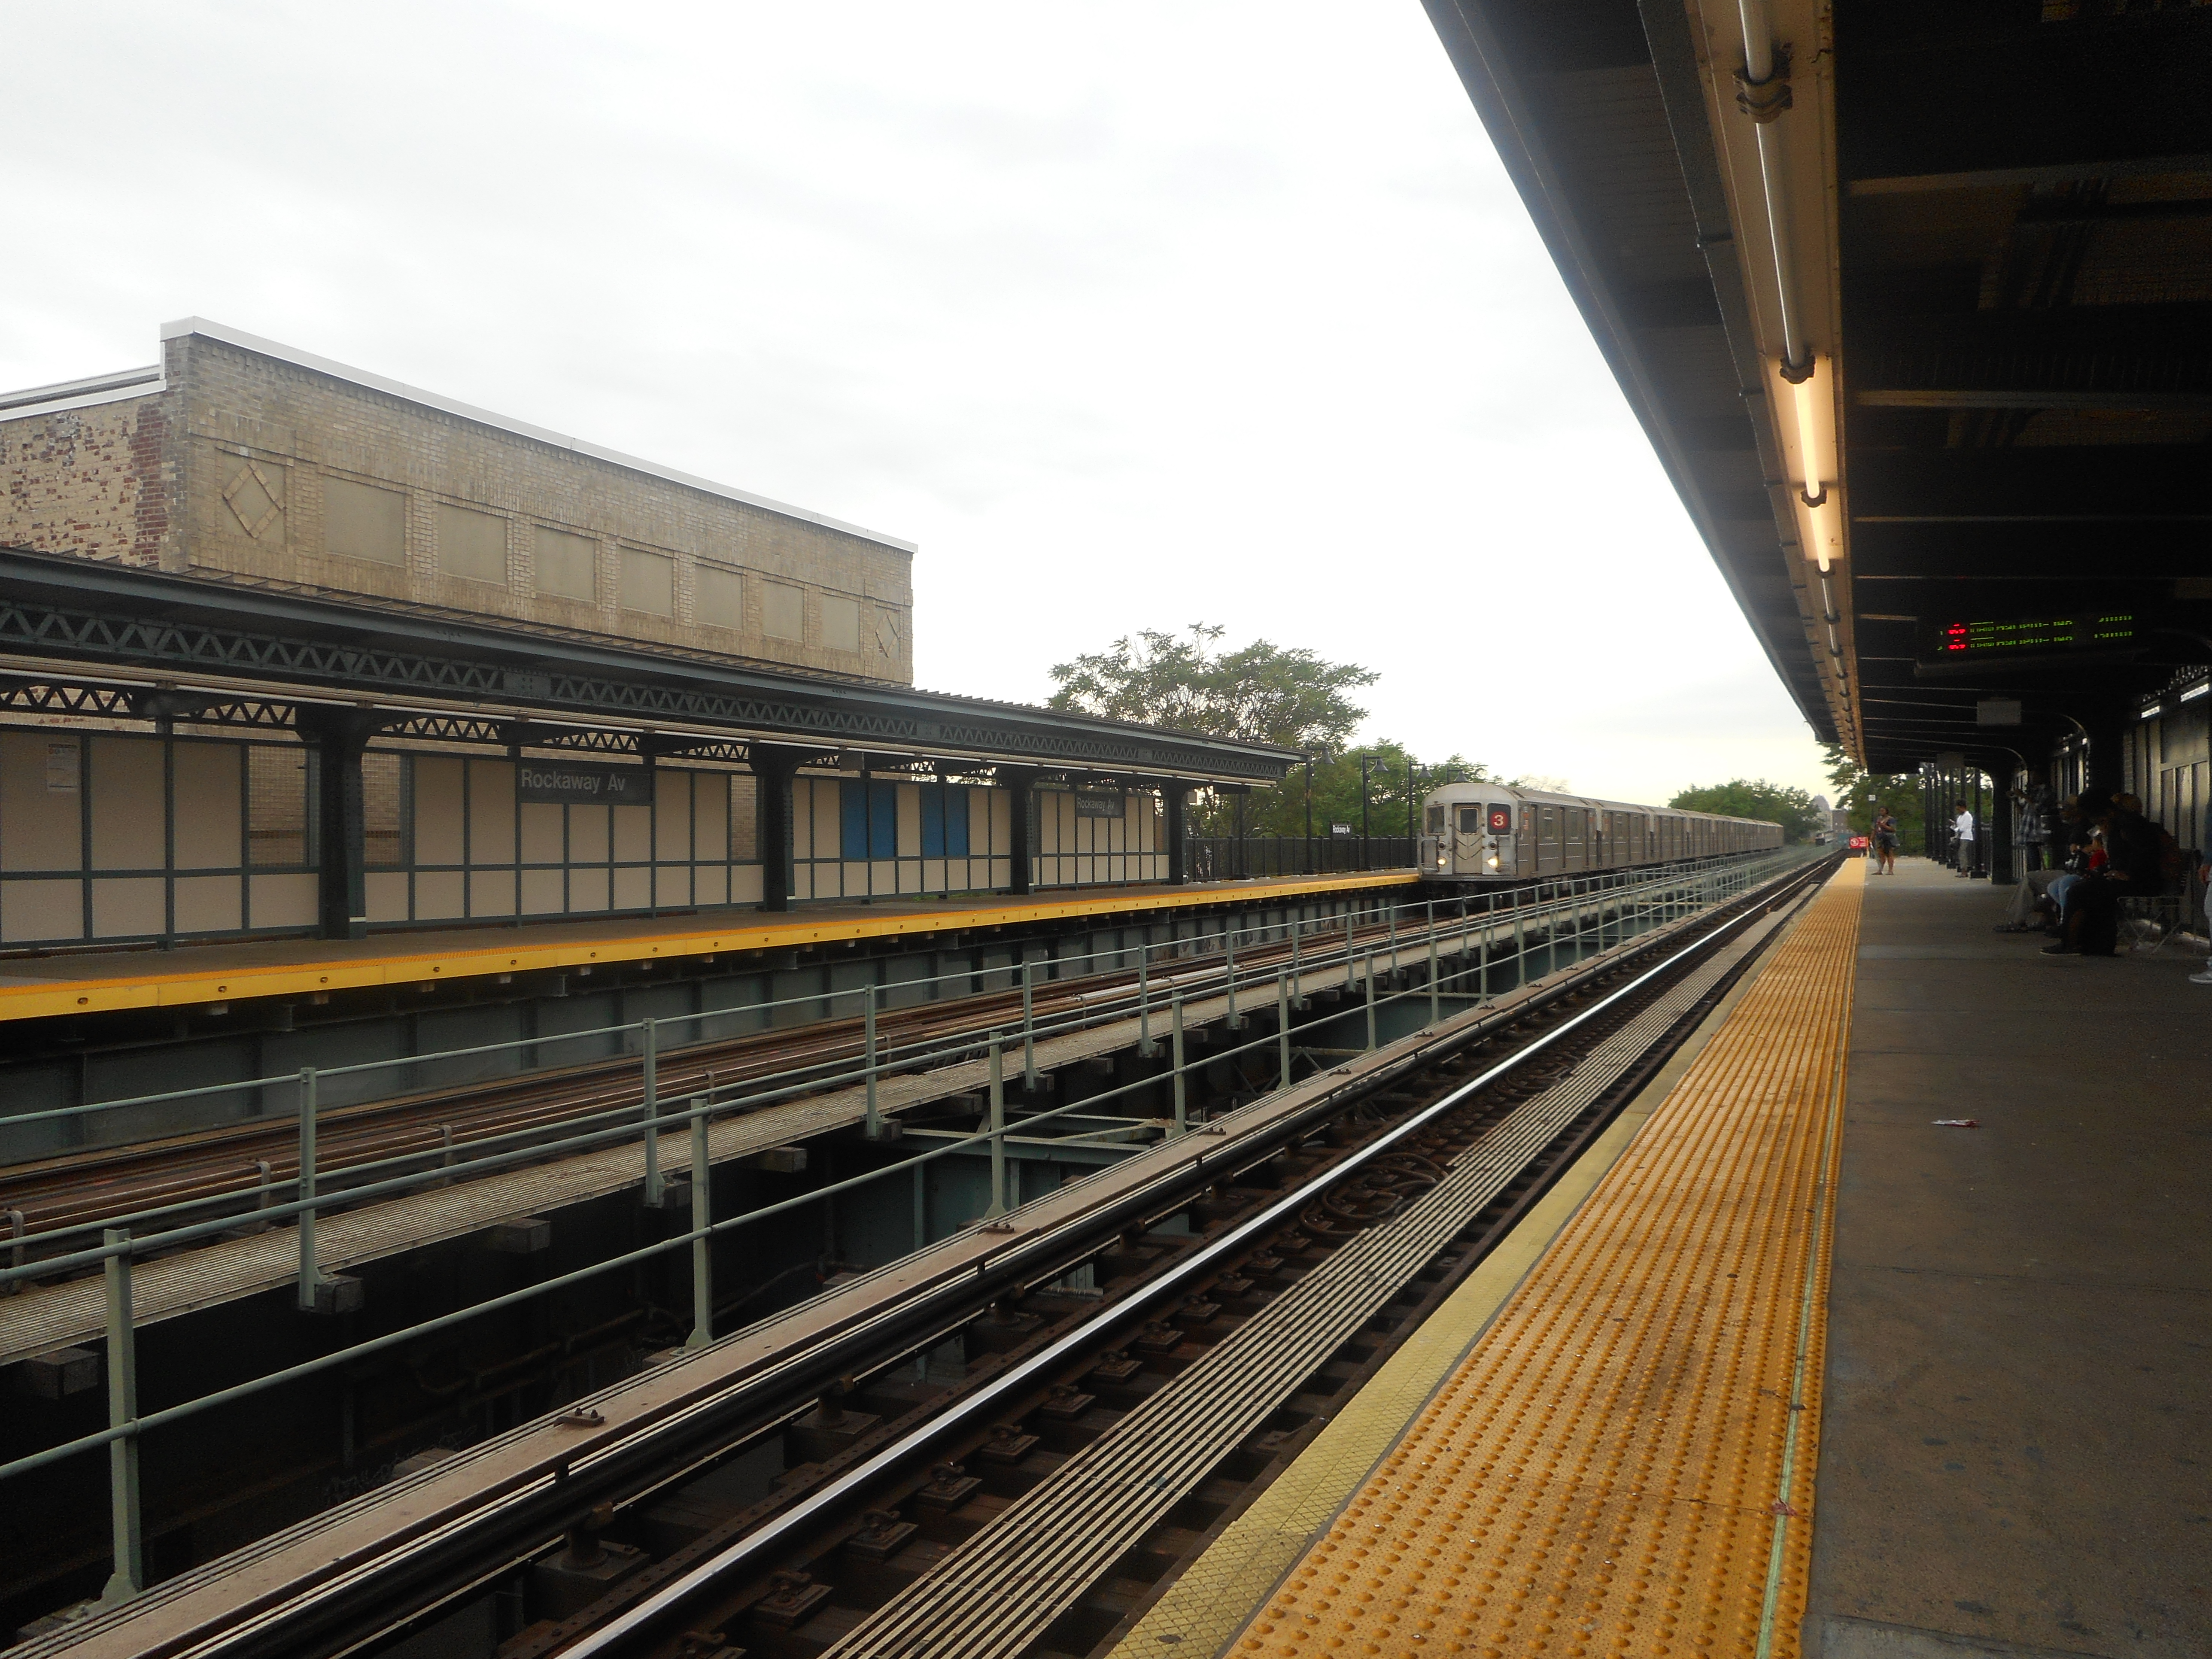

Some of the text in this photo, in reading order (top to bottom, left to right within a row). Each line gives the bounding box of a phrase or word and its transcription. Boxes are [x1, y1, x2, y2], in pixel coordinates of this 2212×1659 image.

[521, 769, 626, 794] Rockaway Av
[1077, 797, 1114, 811] Rockaway Av
[1494, 814, 1504, 826] 3
